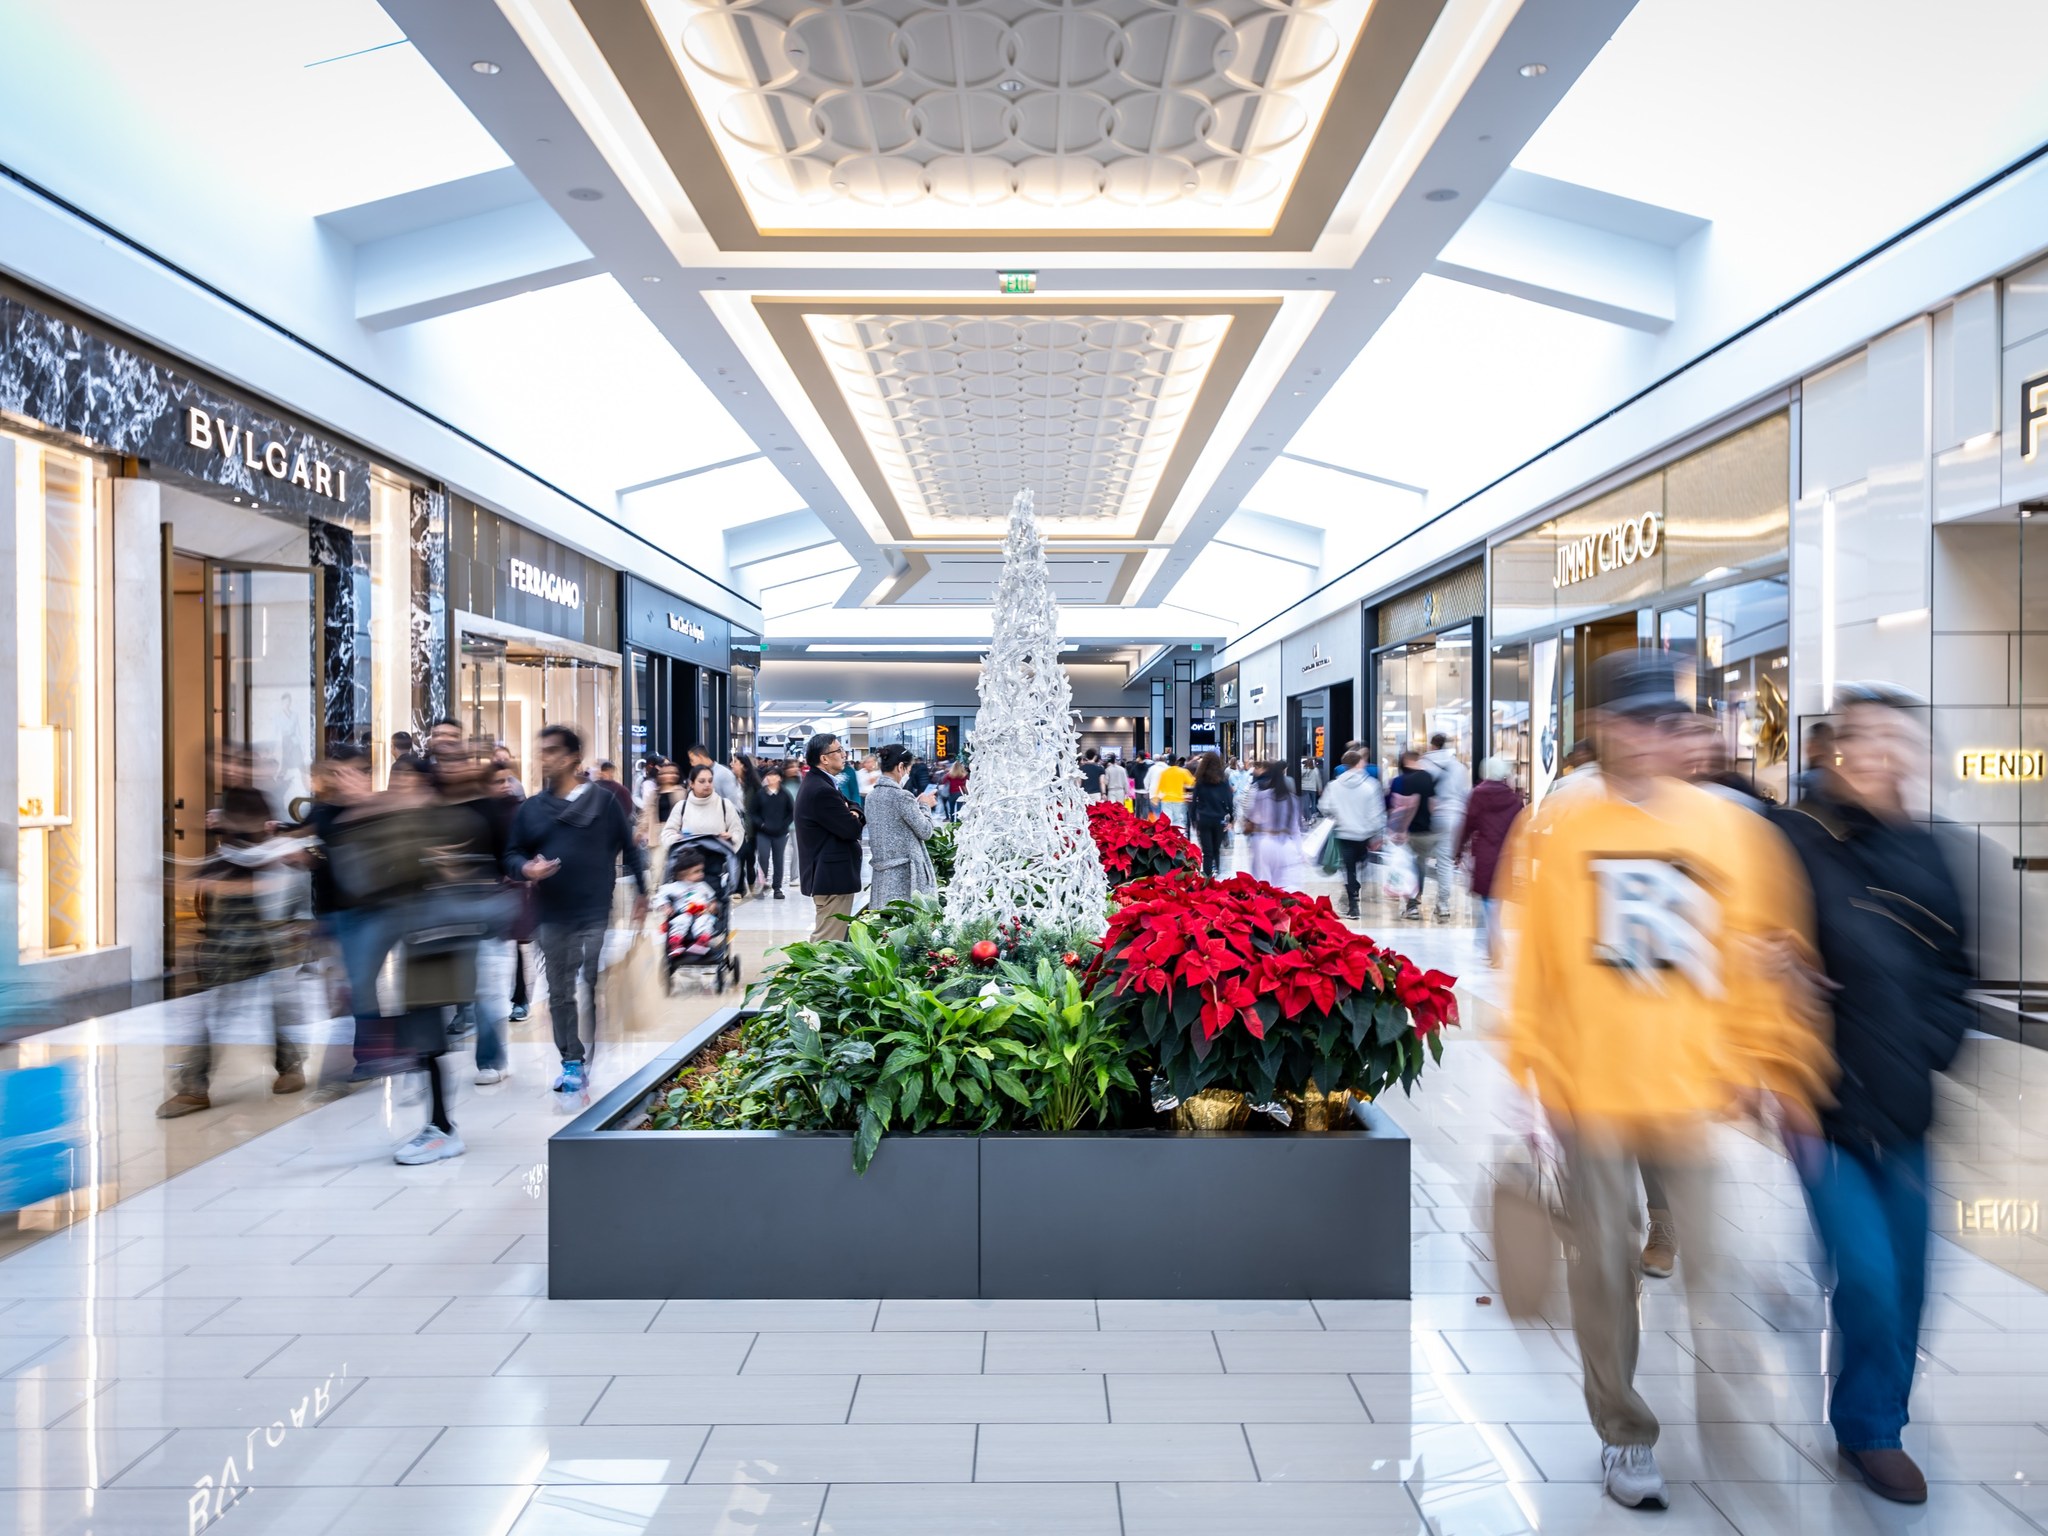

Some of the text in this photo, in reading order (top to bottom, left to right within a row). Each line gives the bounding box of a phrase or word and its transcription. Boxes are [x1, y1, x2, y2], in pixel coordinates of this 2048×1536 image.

[186, 406, 347, 503] BVLGARI
[1552, 511, 1659, 589] JIMMY CHOO
[509, 557, 580, 610] FERRAGAMO
[1962, 753, 2043, 777] FENDI
